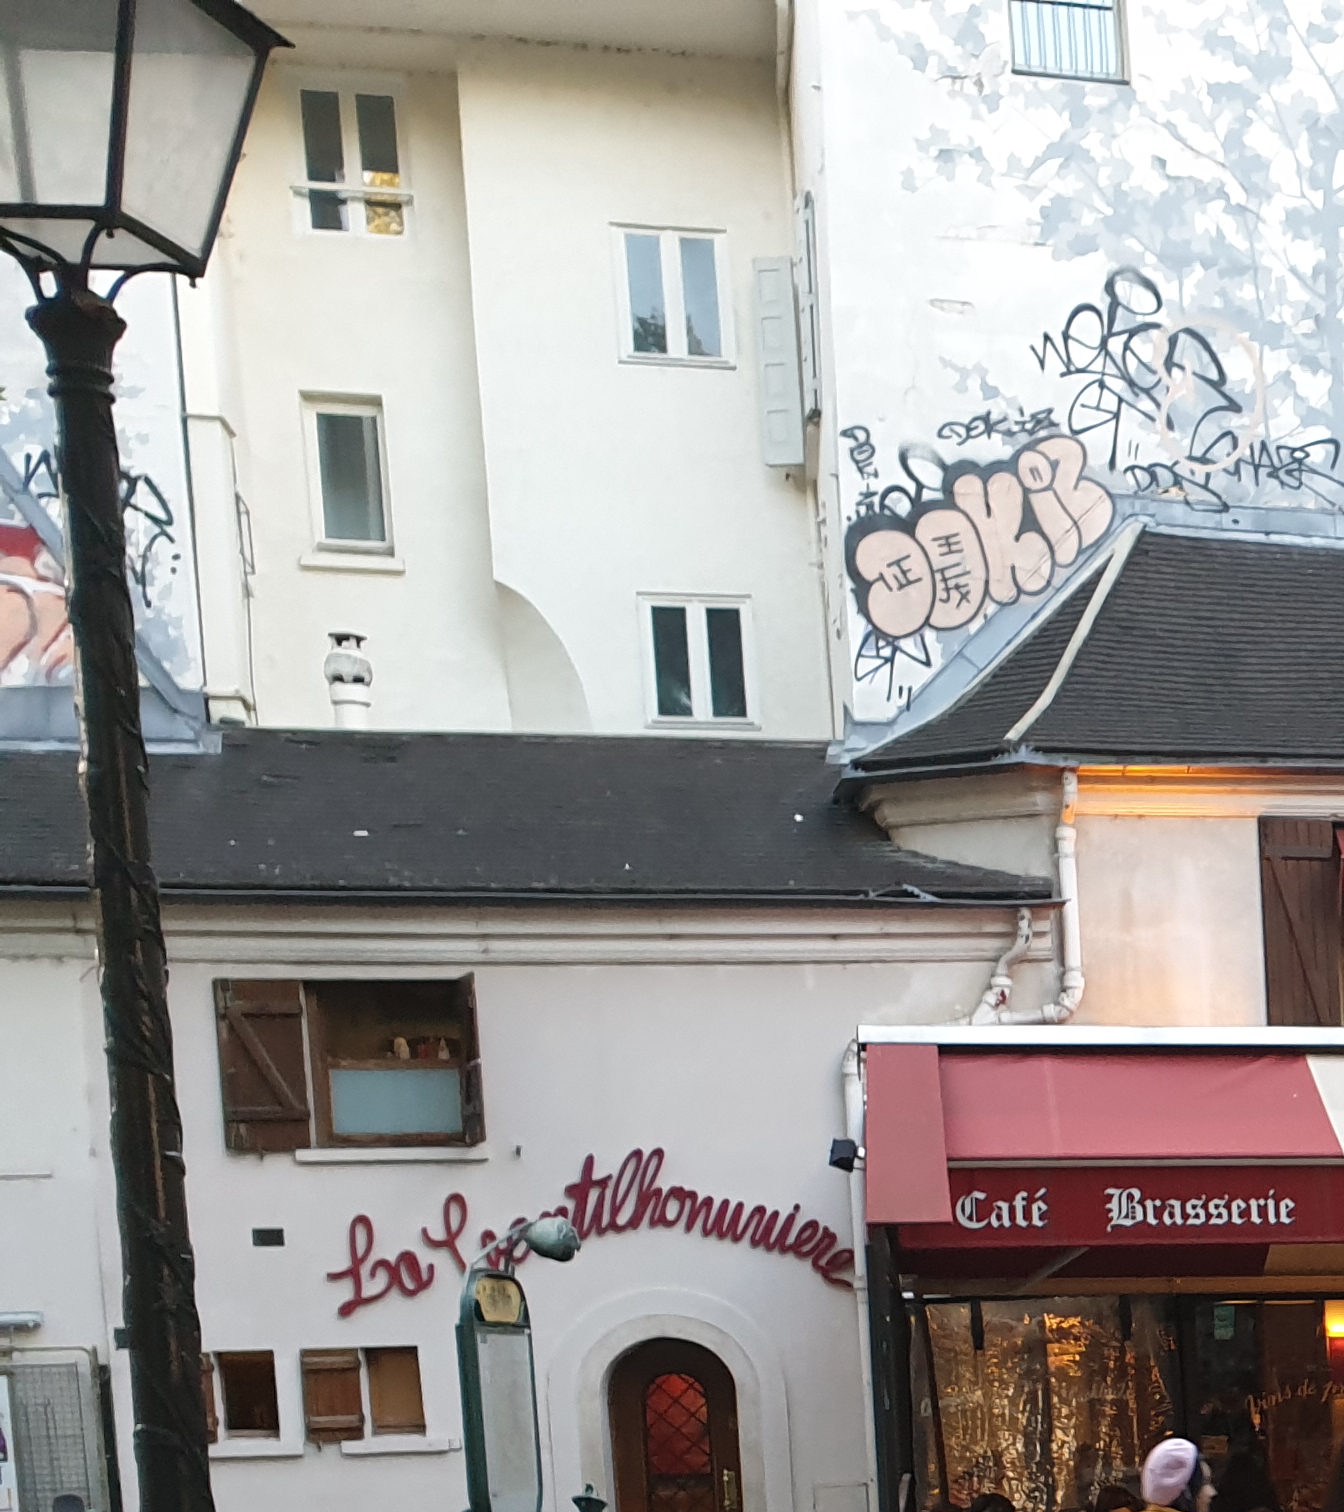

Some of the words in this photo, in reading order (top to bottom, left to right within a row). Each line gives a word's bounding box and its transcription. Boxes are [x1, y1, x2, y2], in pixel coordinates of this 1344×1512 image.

[955, 1187, 1048, 1229] Café
[1103, 1187, 1296, 1233] Brasserie
[327, 1214, 435, 1318] La
